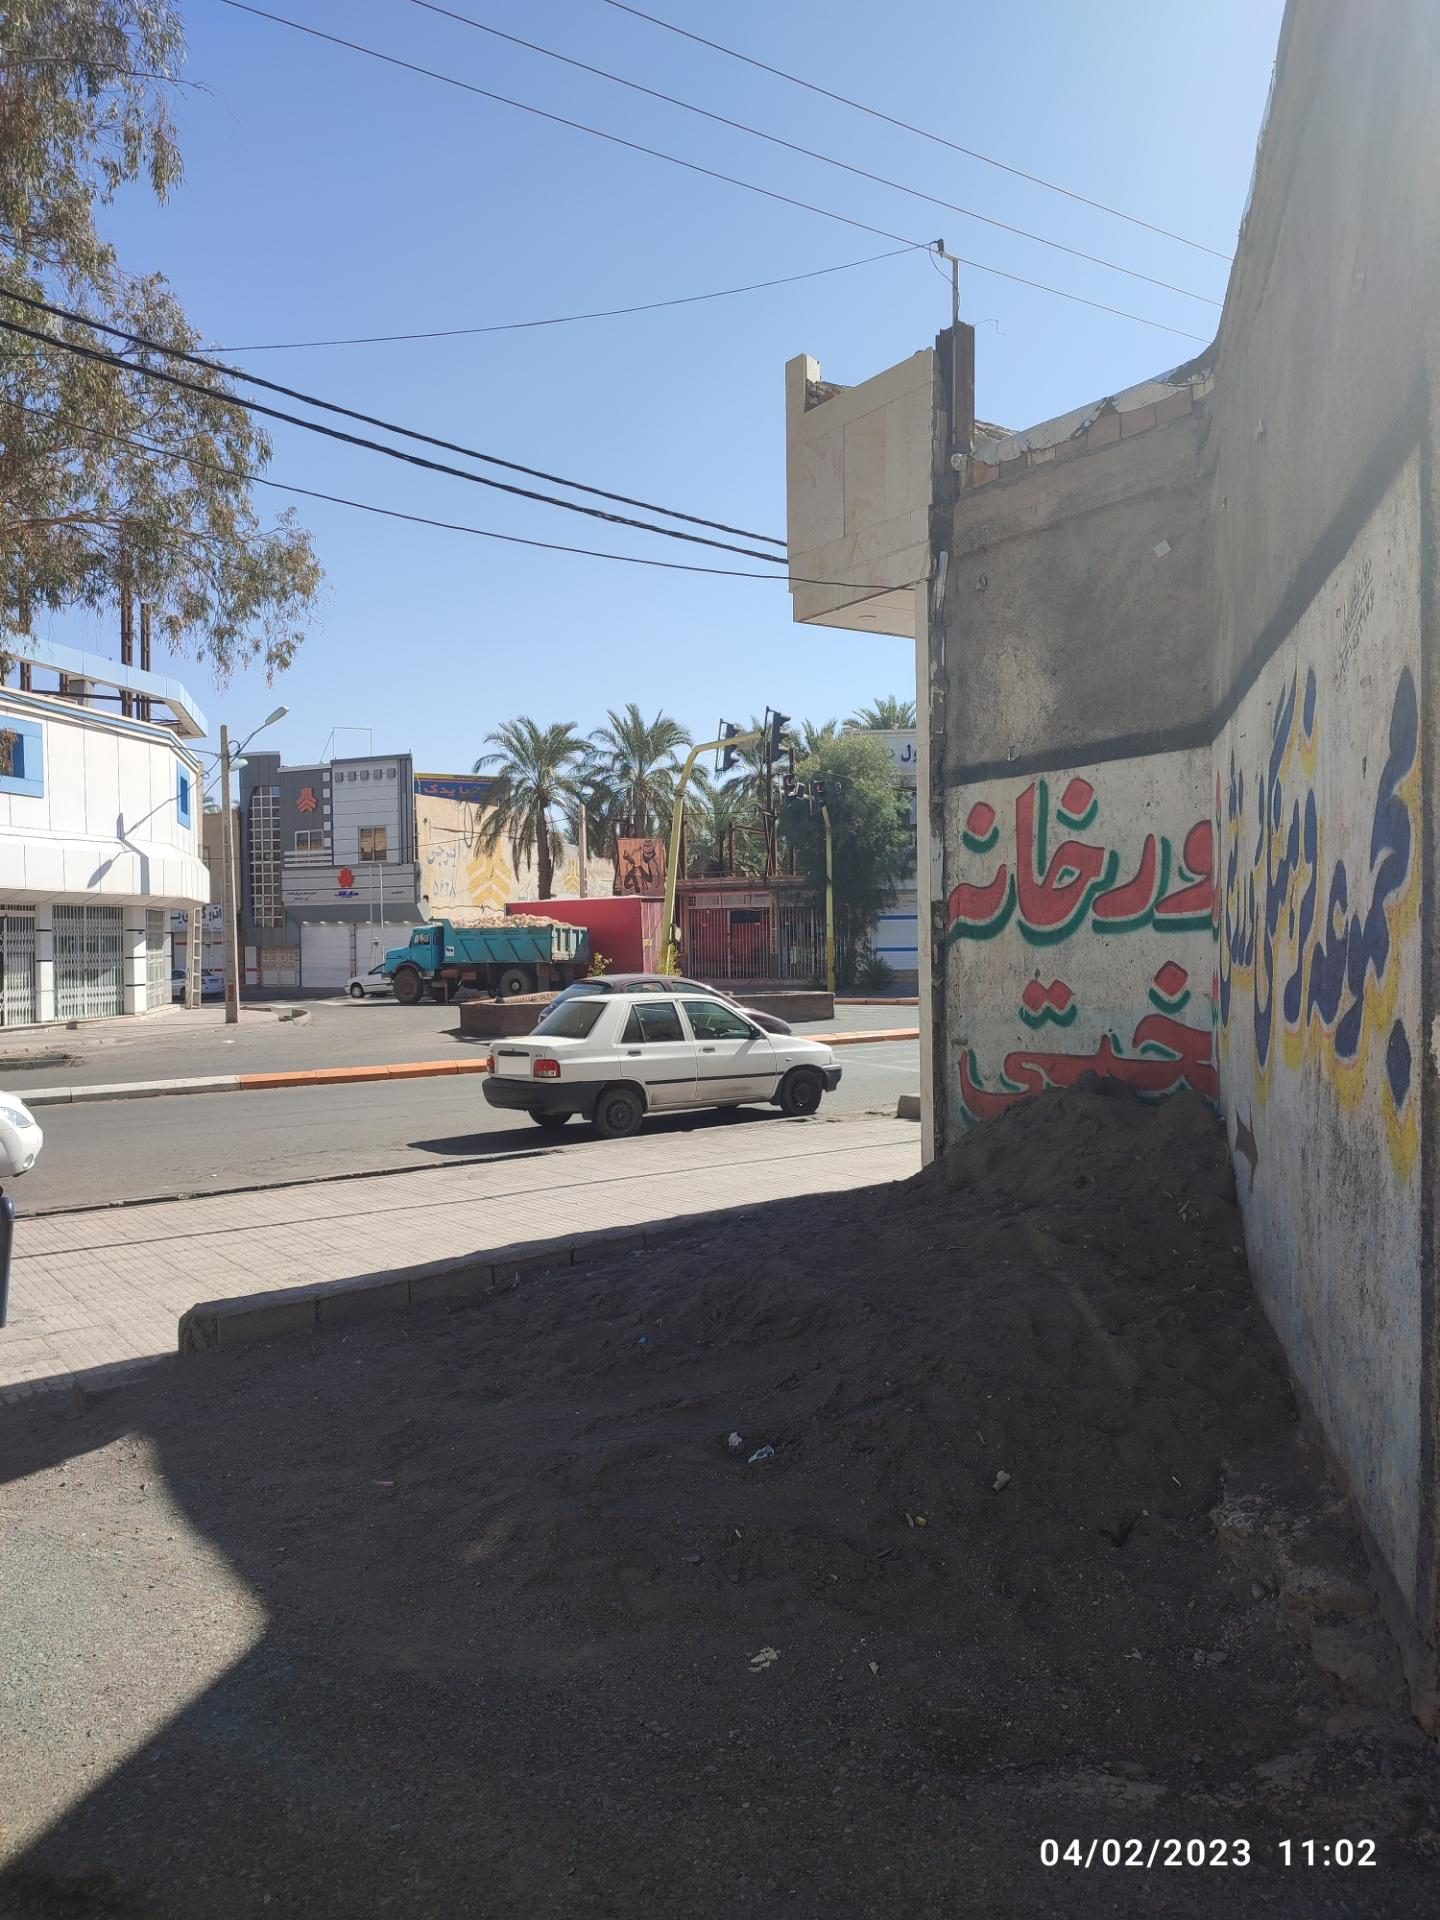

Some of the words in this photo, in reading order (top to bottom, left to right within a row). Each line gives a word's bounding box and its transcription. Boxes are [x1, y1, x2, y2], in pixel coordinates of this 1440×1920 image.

[947, 768, 1221, 942] زورخانه
[1219, 748, 1256, 1028] ورزشی
[1254, 652, 1318, 1067] فرهنگی
[1307, 665, 1418, 1110] مجموعه
[960, 960, 1222, 1124] تختی
